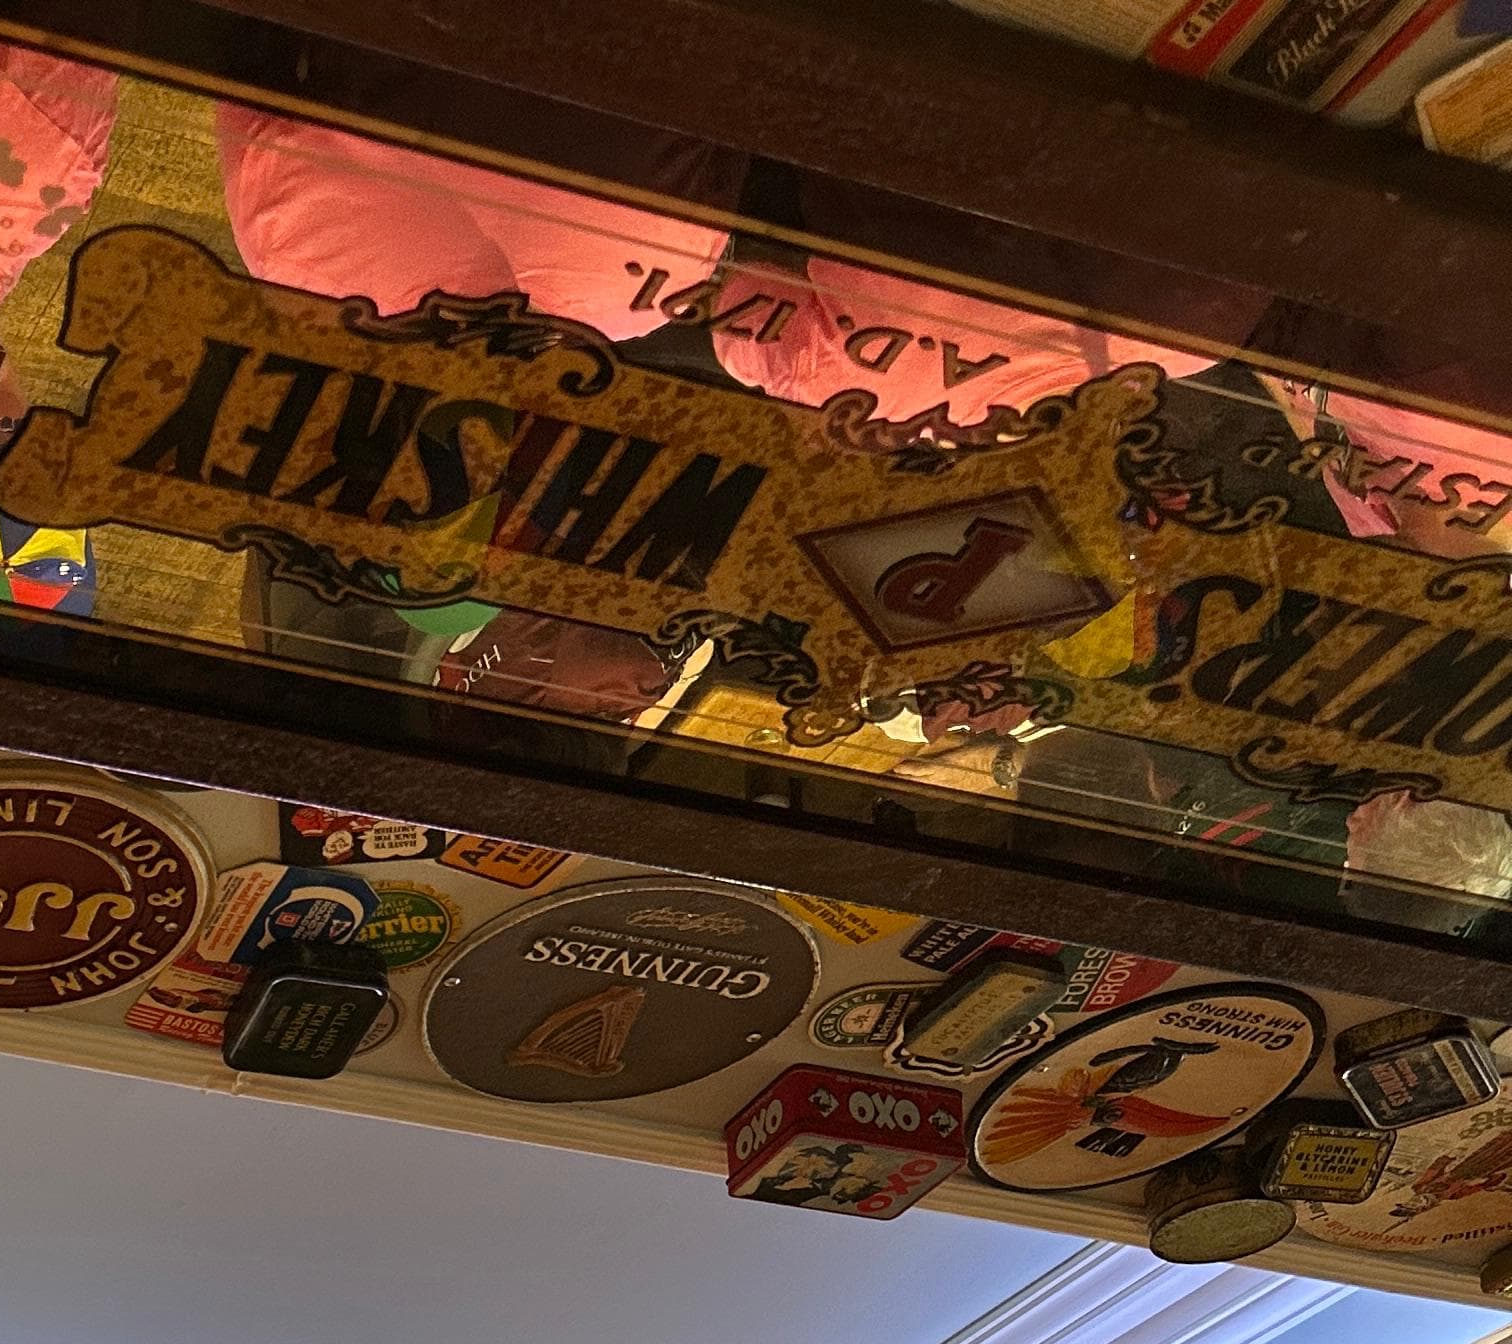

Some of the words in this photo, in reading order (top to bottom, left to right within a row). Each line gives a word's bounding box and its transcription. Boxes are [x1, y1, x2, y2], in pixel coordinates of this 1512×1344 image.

[835, 316, 1012, 391] A.D.
[117, 337, 769, 595] WHISKEY
[96, 819, 178, 879] SON
[356, 911, 445, 942] errier
[48, 930, 157, 998] JOHN
[524, 936, 772, 1000] GUINNESS
[1157, 1010, 1296, 1052] GUINNESS
[1186, 1001, 1266, 1026] STRONG
[1265, 1017, 1307, 1034] HIM
[735, 1098, 783, 1161] OXO
[847, 1089, 921, 1133] OXO
[856, 1158, 938, 1213] OXO
